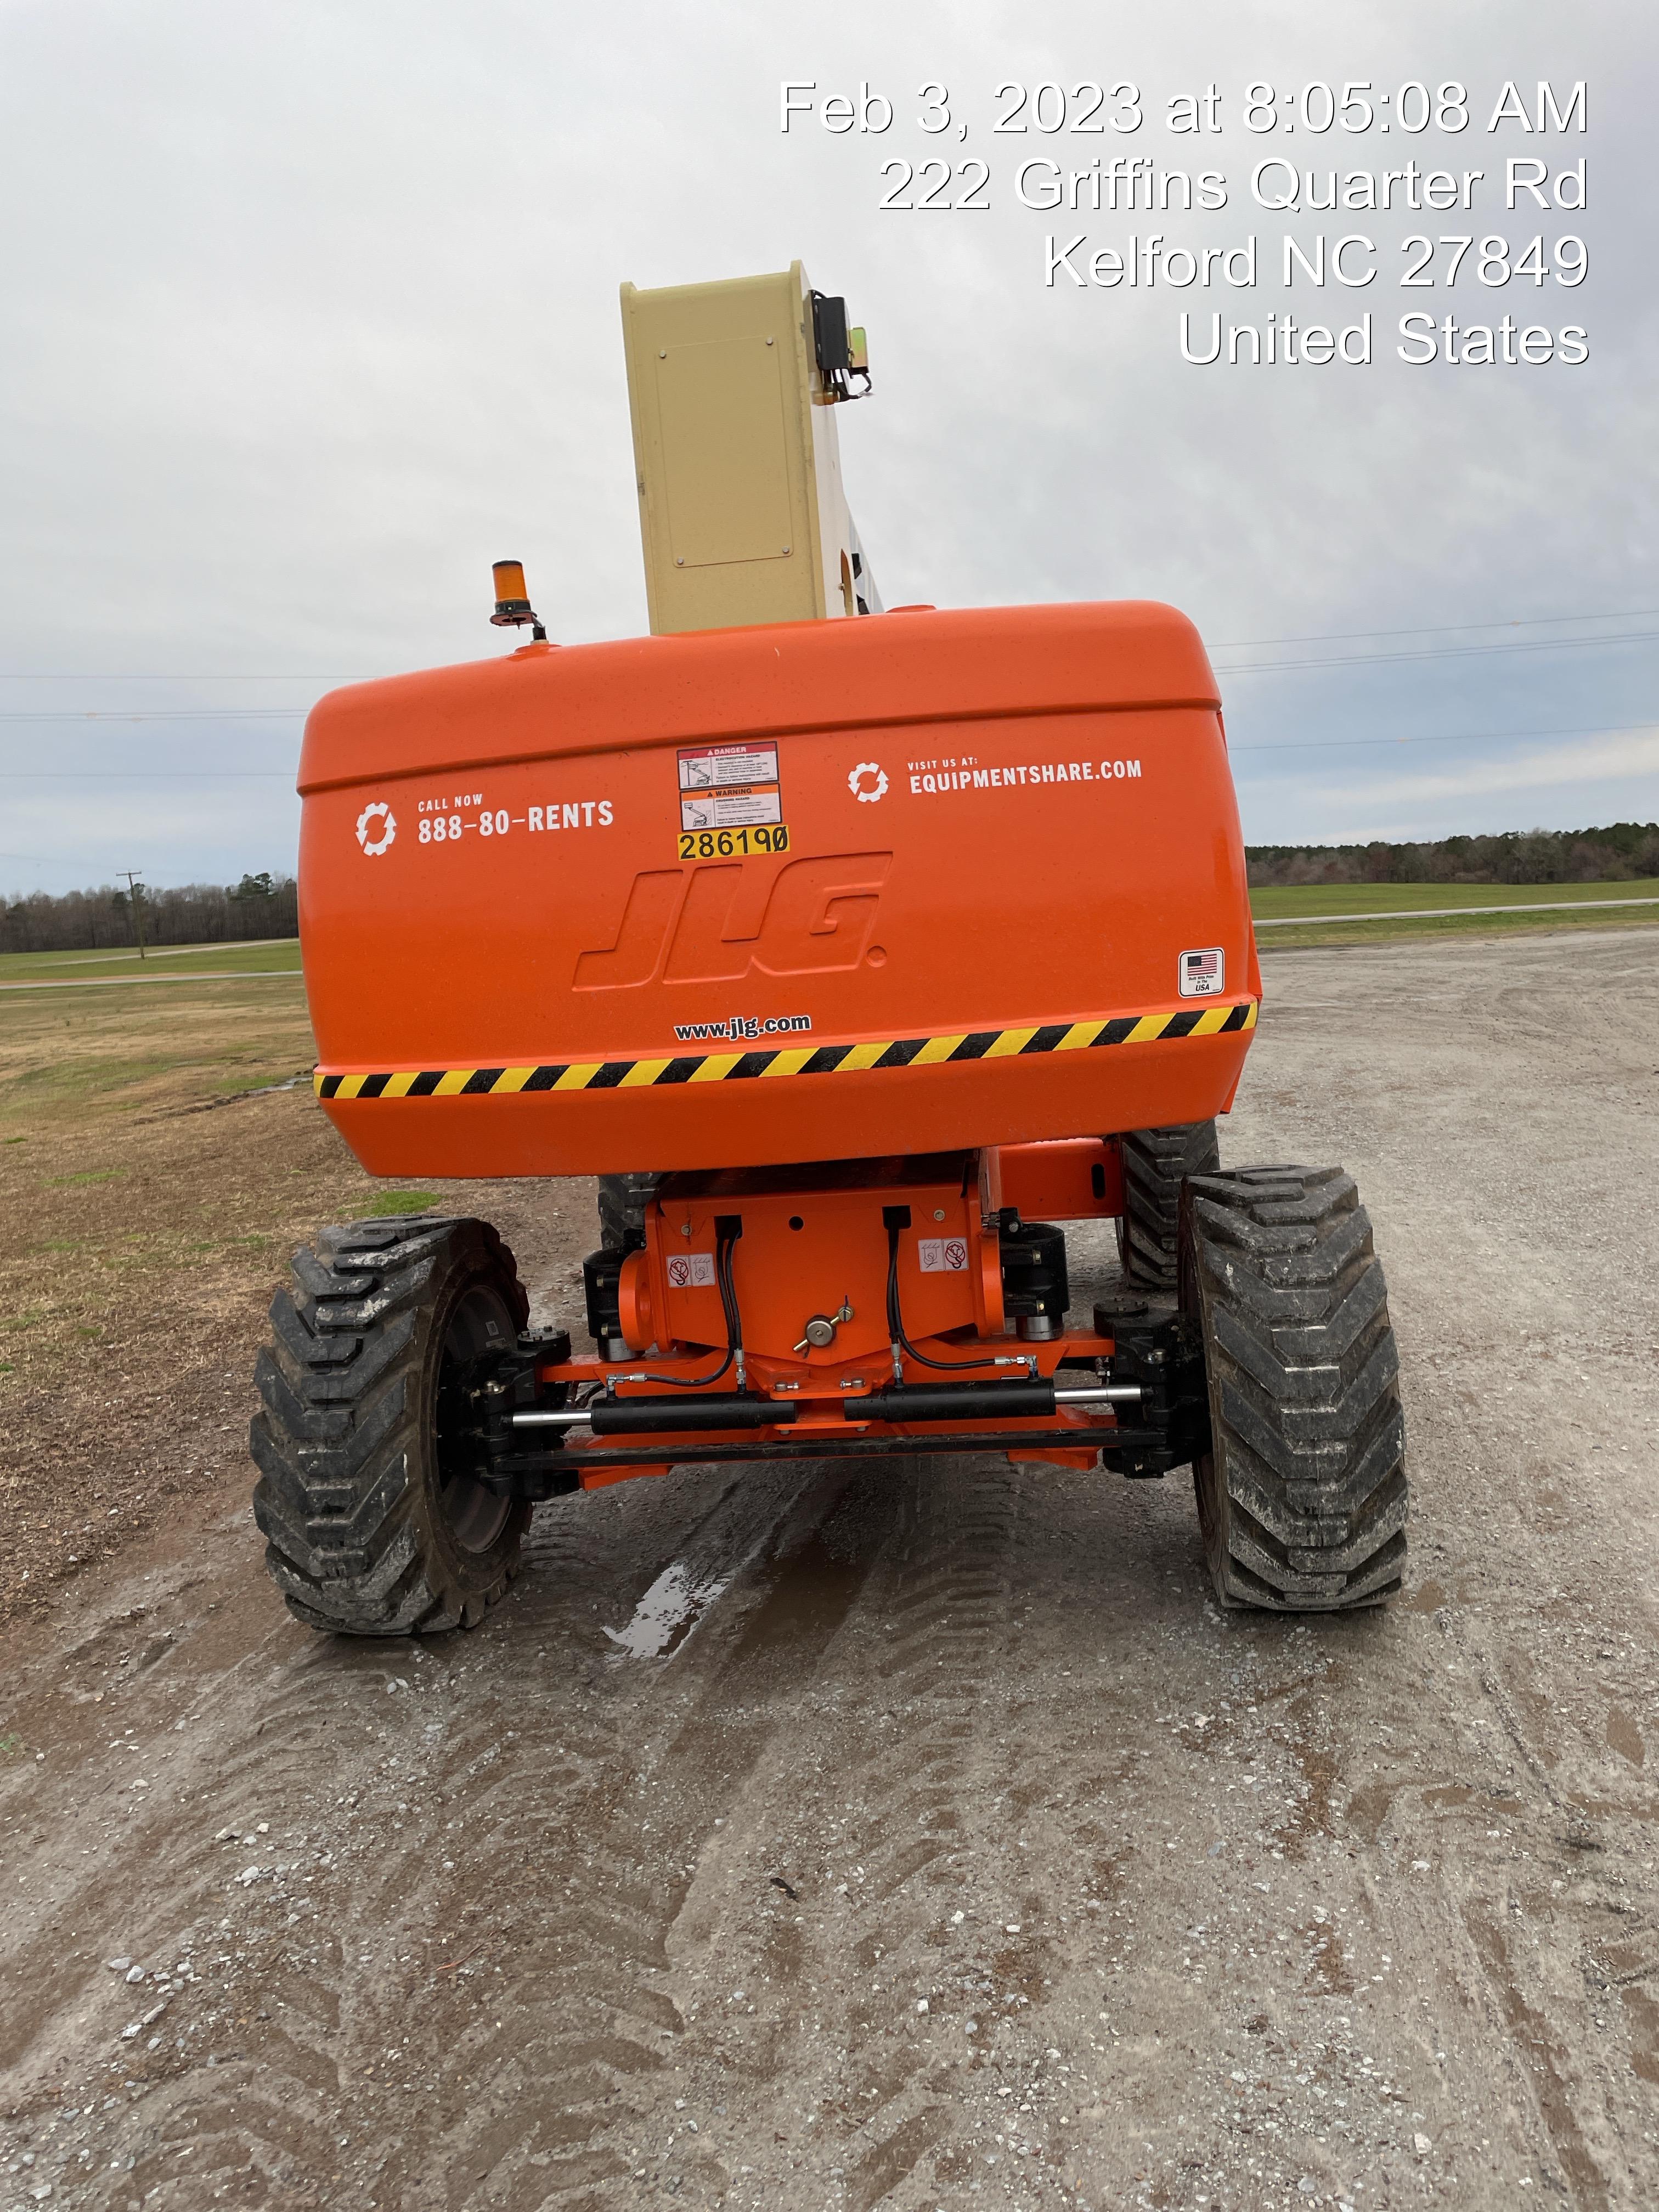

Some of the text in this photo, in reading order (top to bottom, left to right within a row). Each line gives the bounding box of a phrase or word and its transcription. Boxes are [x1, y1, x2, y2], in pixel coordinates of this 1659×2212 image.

[714, 747, 747, 755] DANGER
[907, 757, 978, 771] VISIT US AT:
[909, 759, 1142, 794] EQUIPMENTSHARE.COM
[715, 788, 752, 797] WARNING
[417, 793, 483, 813] CALL NOW
[417, 800, 614, 844] 888-80-RENTS
[674, 1015, 811, 1040] www.jlg.com
